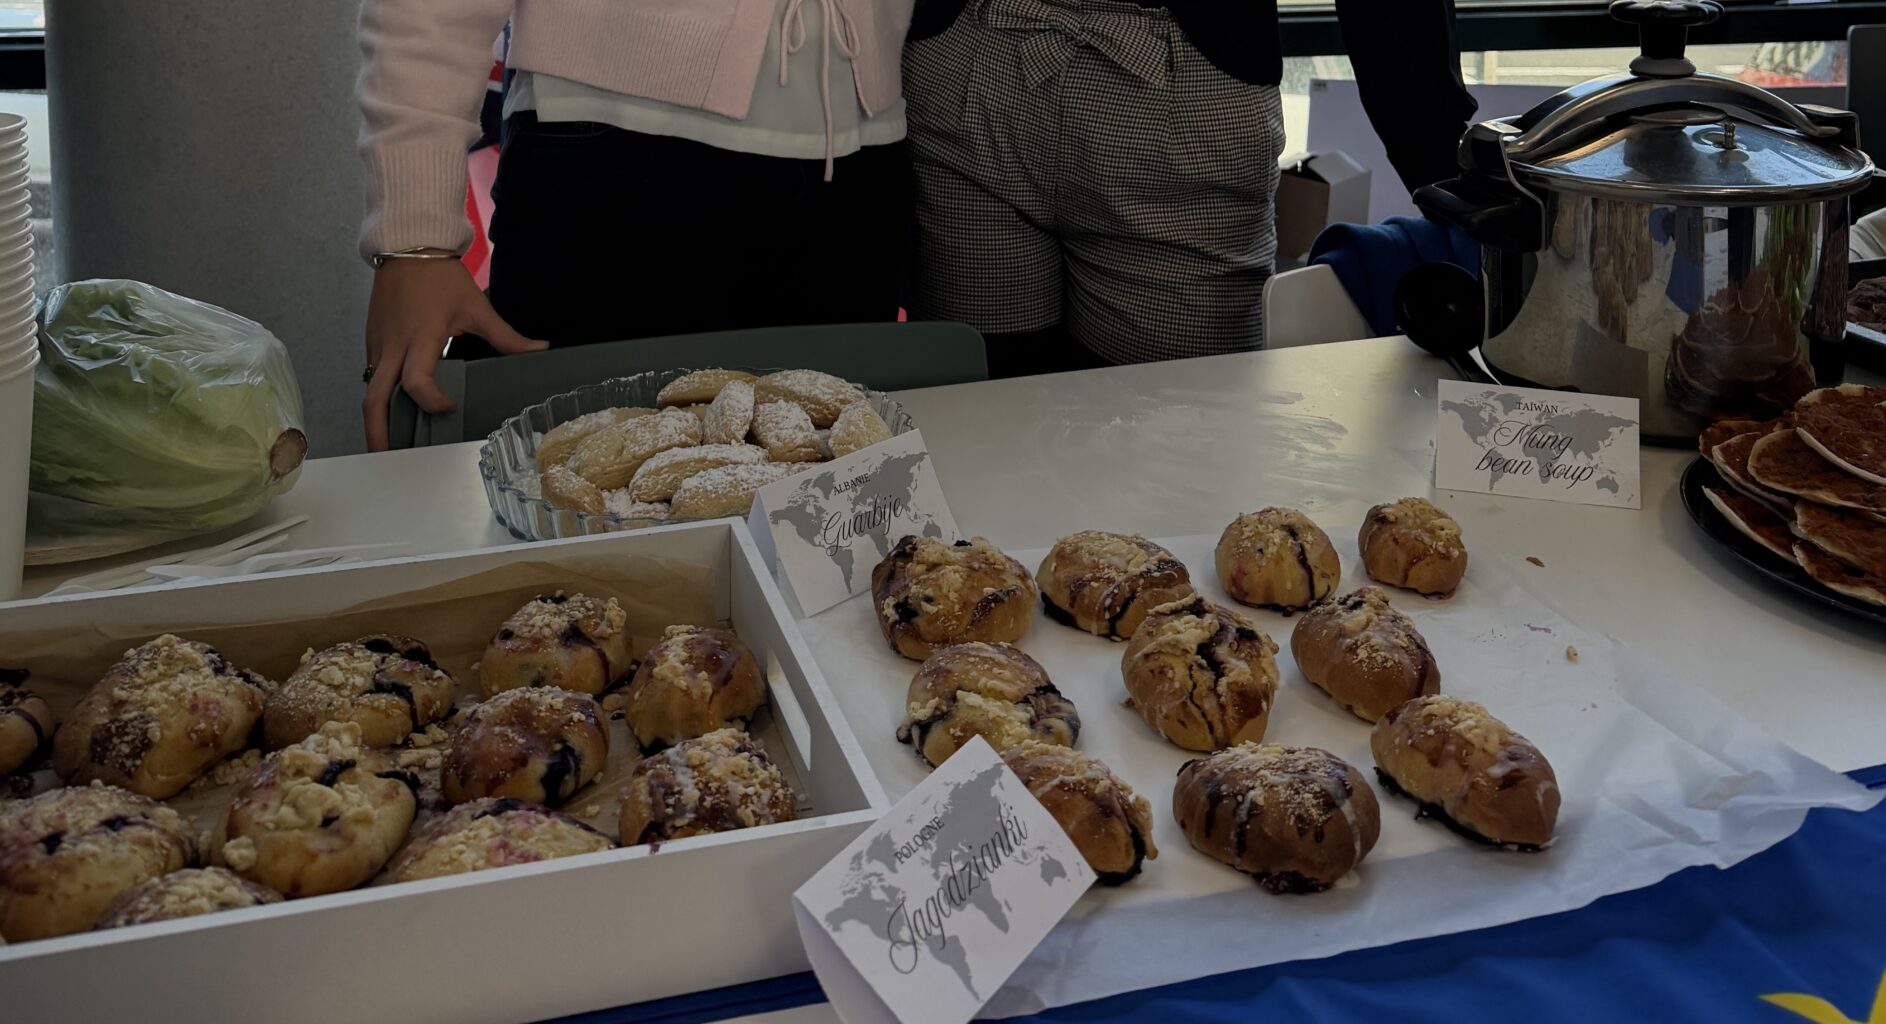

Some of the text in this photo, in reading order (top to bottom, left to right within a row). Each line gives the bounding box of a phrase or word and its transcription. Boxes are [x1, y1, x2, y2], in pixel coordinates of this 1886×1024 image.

[1493, 420, 1574, 461] Mung
[833, 472, 871, 496] ALBANIE
[1475, 446, 1594, 490] bean soup
[894, 815, 945, 864] POLOGNE
[887, 804, 1029, 974] Jagodzianki
